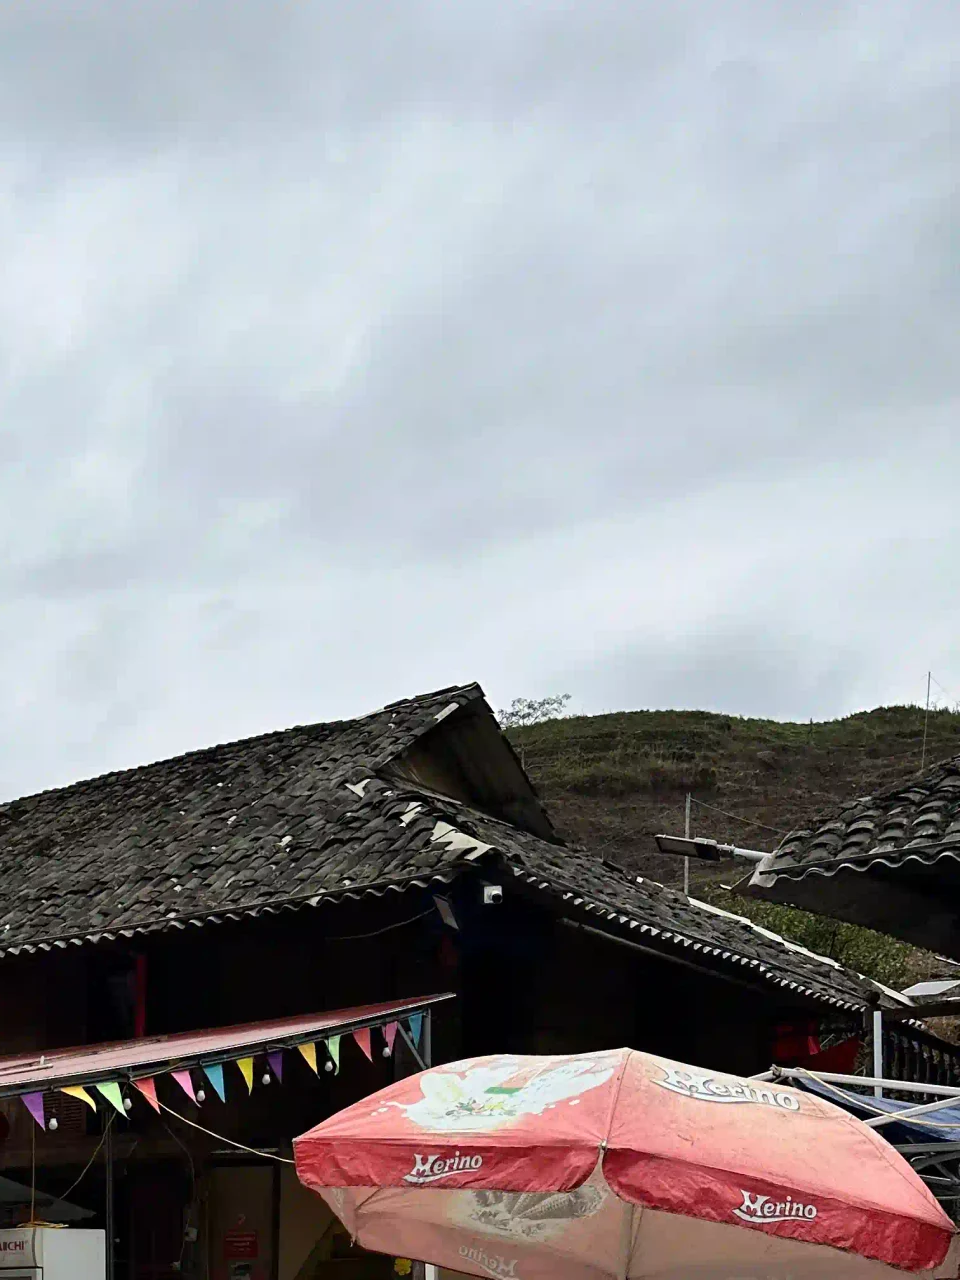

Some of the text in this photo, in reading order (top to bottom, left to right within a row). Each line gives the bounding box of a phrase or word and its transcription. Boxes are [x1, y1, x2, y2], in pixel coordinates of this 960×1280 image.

[651, 1062, 801, 1112] Merino
[404, 1150, 483, 1182] Merino
[734, 1189, 818, 1222] Merino
